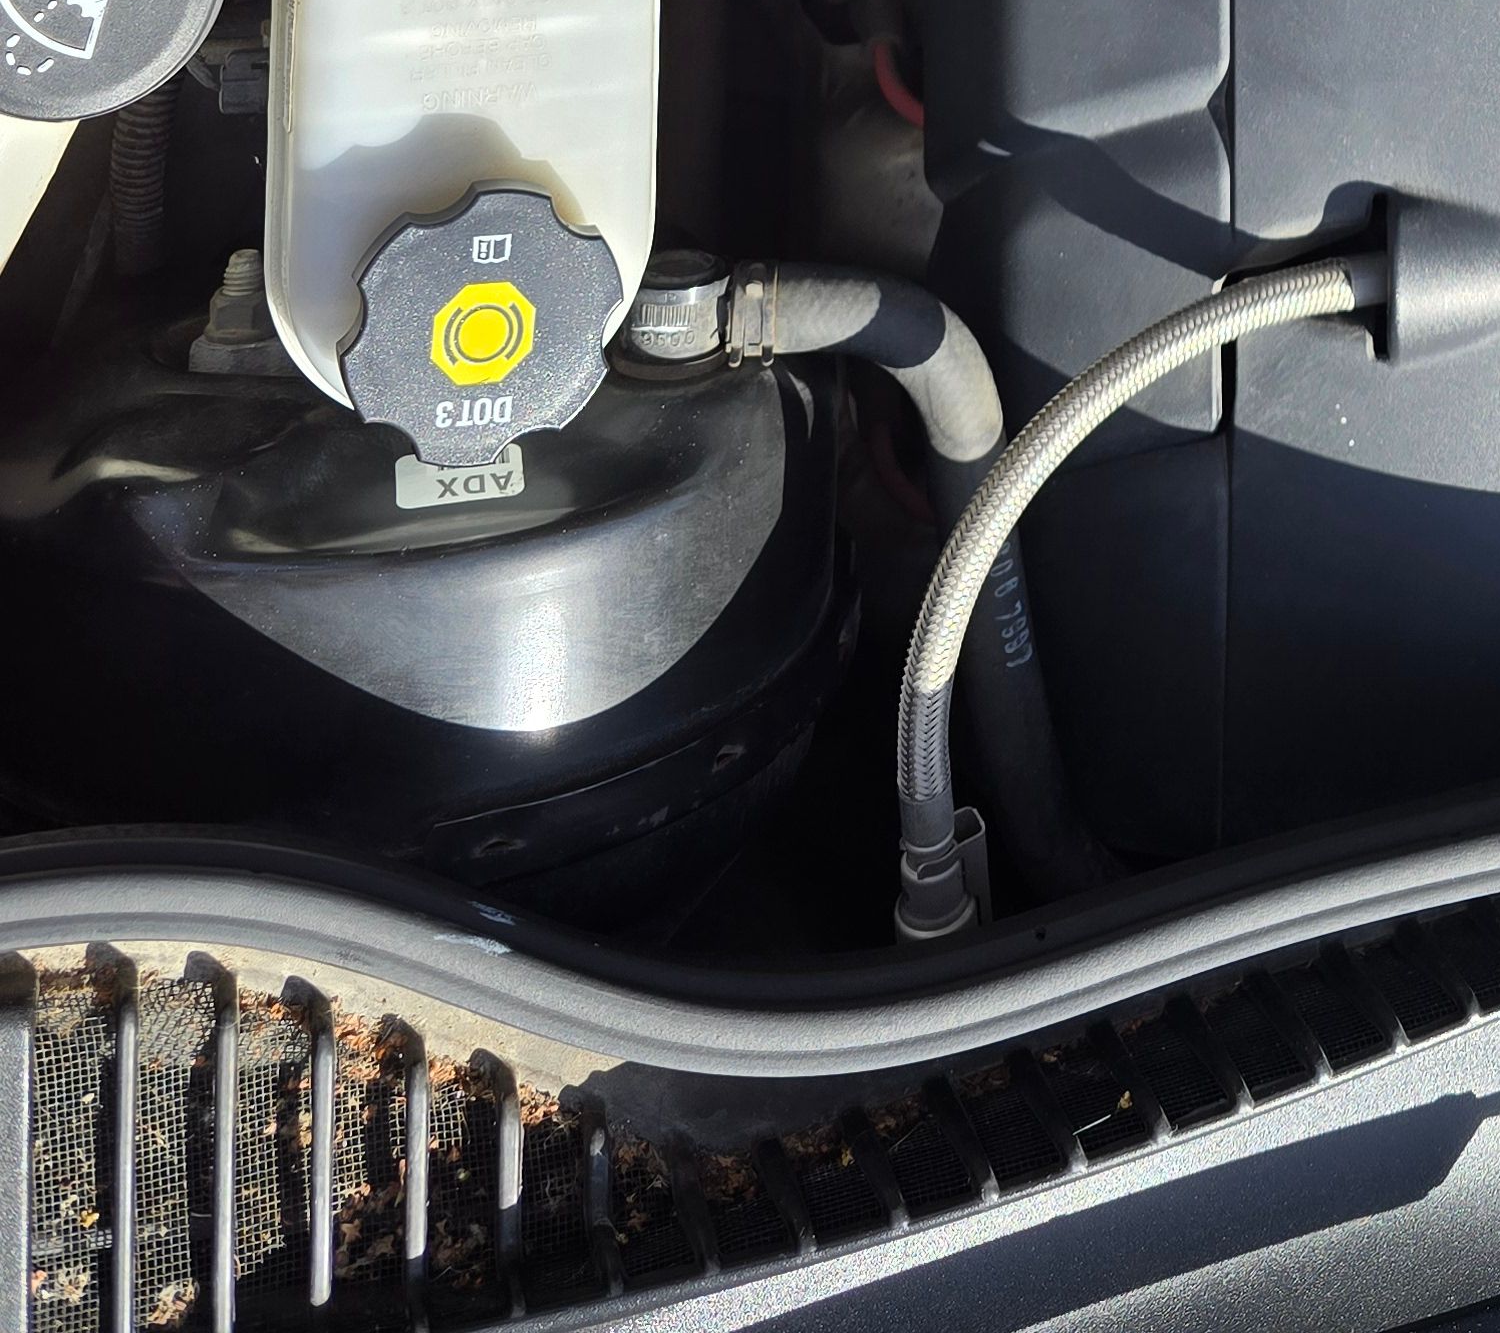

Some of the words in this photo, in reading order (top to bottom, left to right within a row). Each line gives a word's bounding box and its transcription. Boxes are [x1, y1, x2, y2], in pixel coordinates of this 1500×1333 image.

[422, 77, 537, 112] WARNING
[434, 400, 454, 428] 3
[455, 395, 513, 427] DOT
[435, 469, 513, 499] ADX
